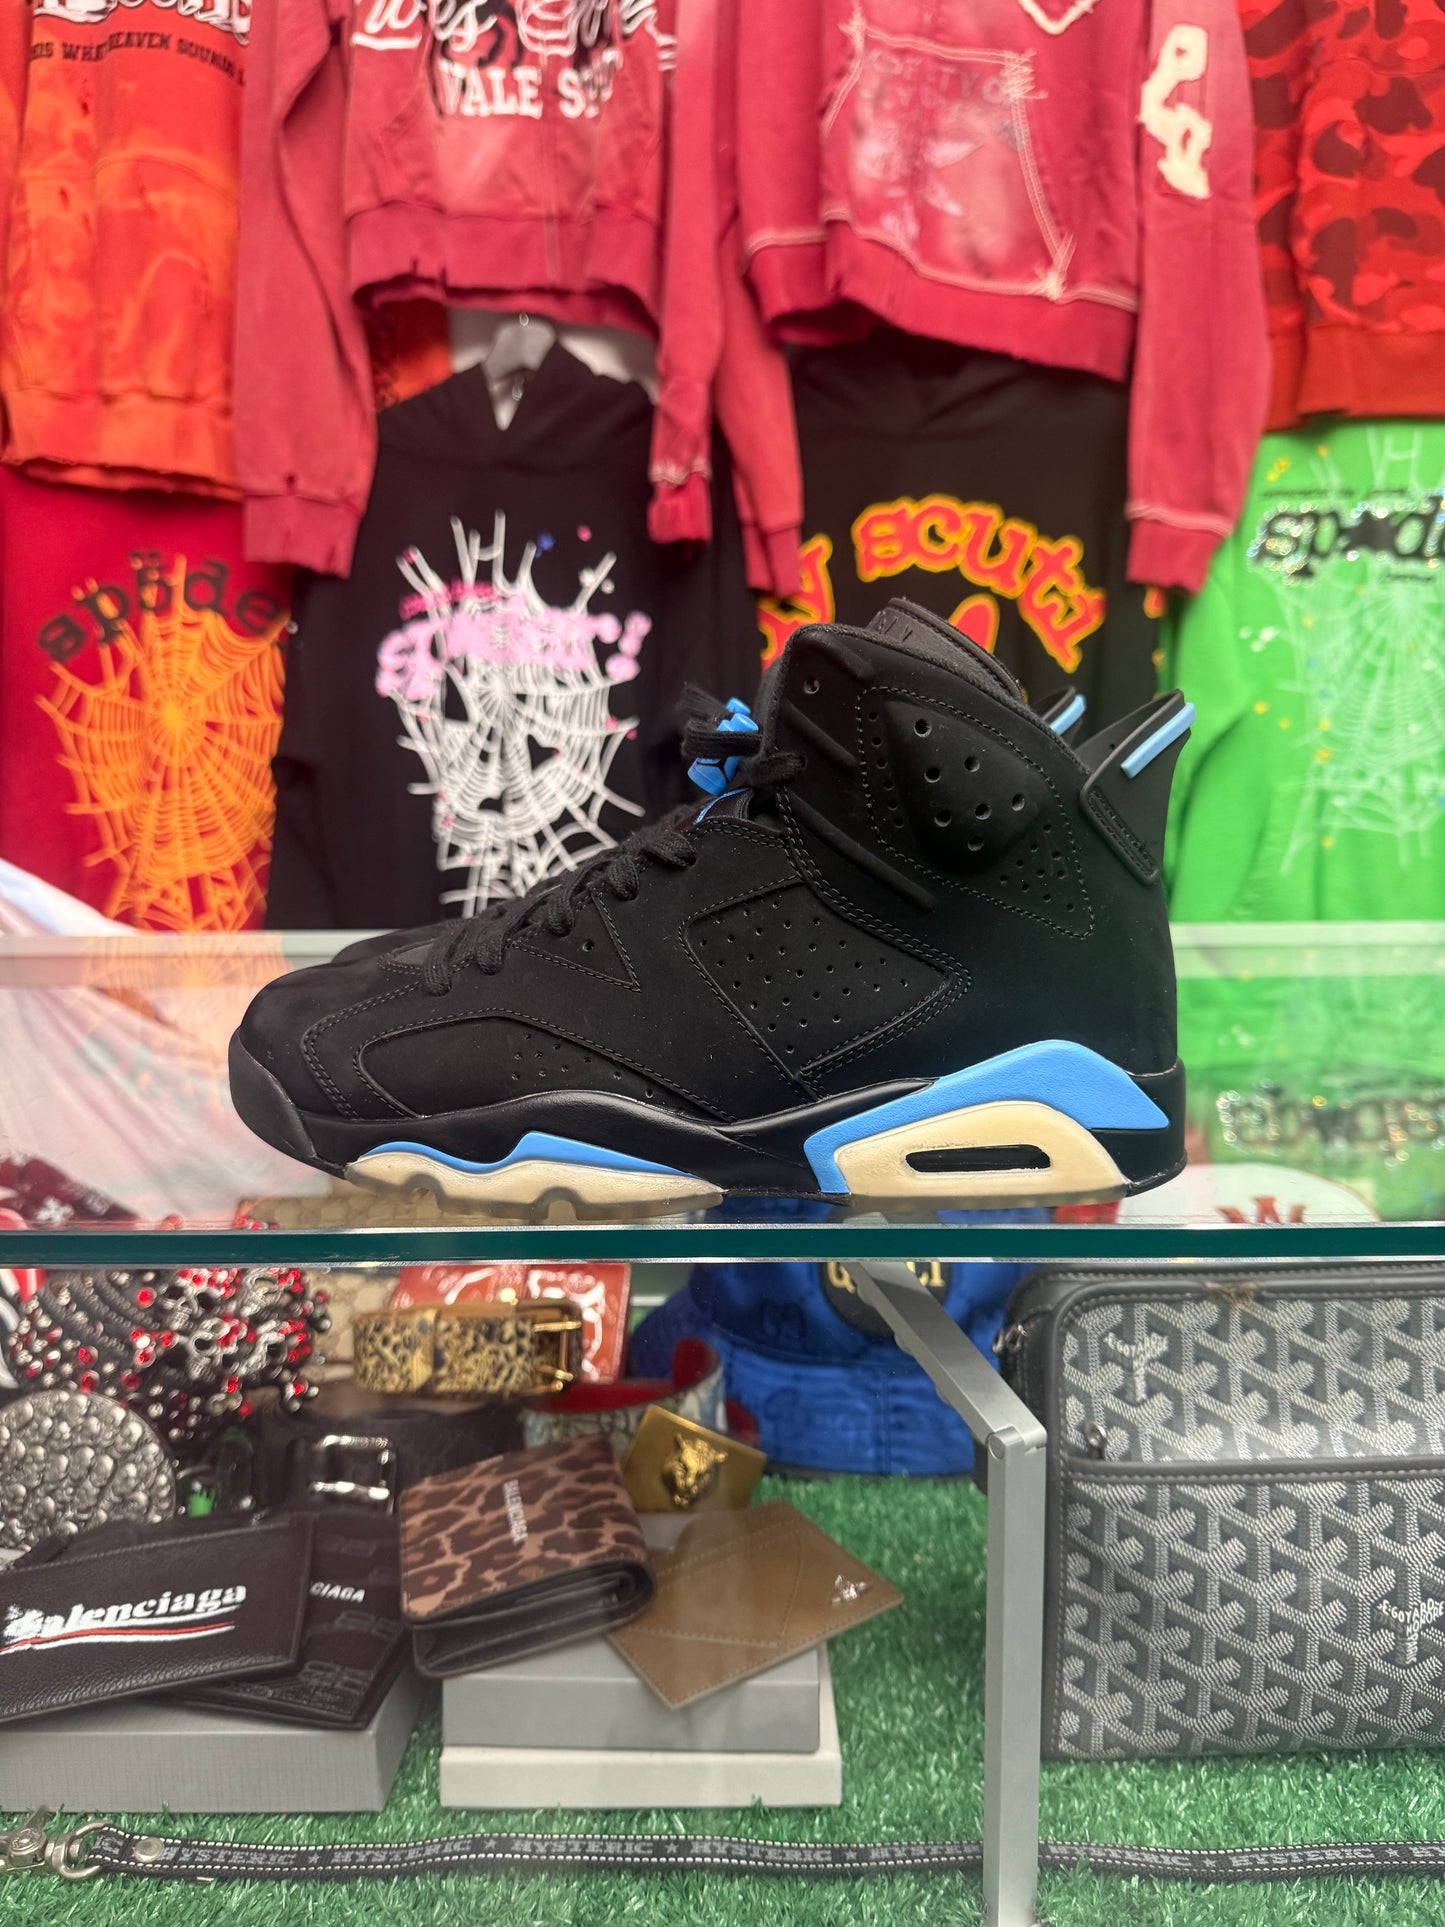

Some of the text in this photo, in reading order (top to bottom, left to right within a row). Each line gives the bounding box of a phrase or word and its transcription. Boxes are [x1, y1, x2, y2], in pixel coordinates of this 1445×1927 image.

[437, 57, 544, 119] VALE
[331, 1838, 472, 1864] HYSTERIC
[511, 1840, 653, 1855] HYSTERIC
[690, 1841, 833, 1862] HYSTERIC
[1230, 1848, 1376, 1868] HYSTERIC
